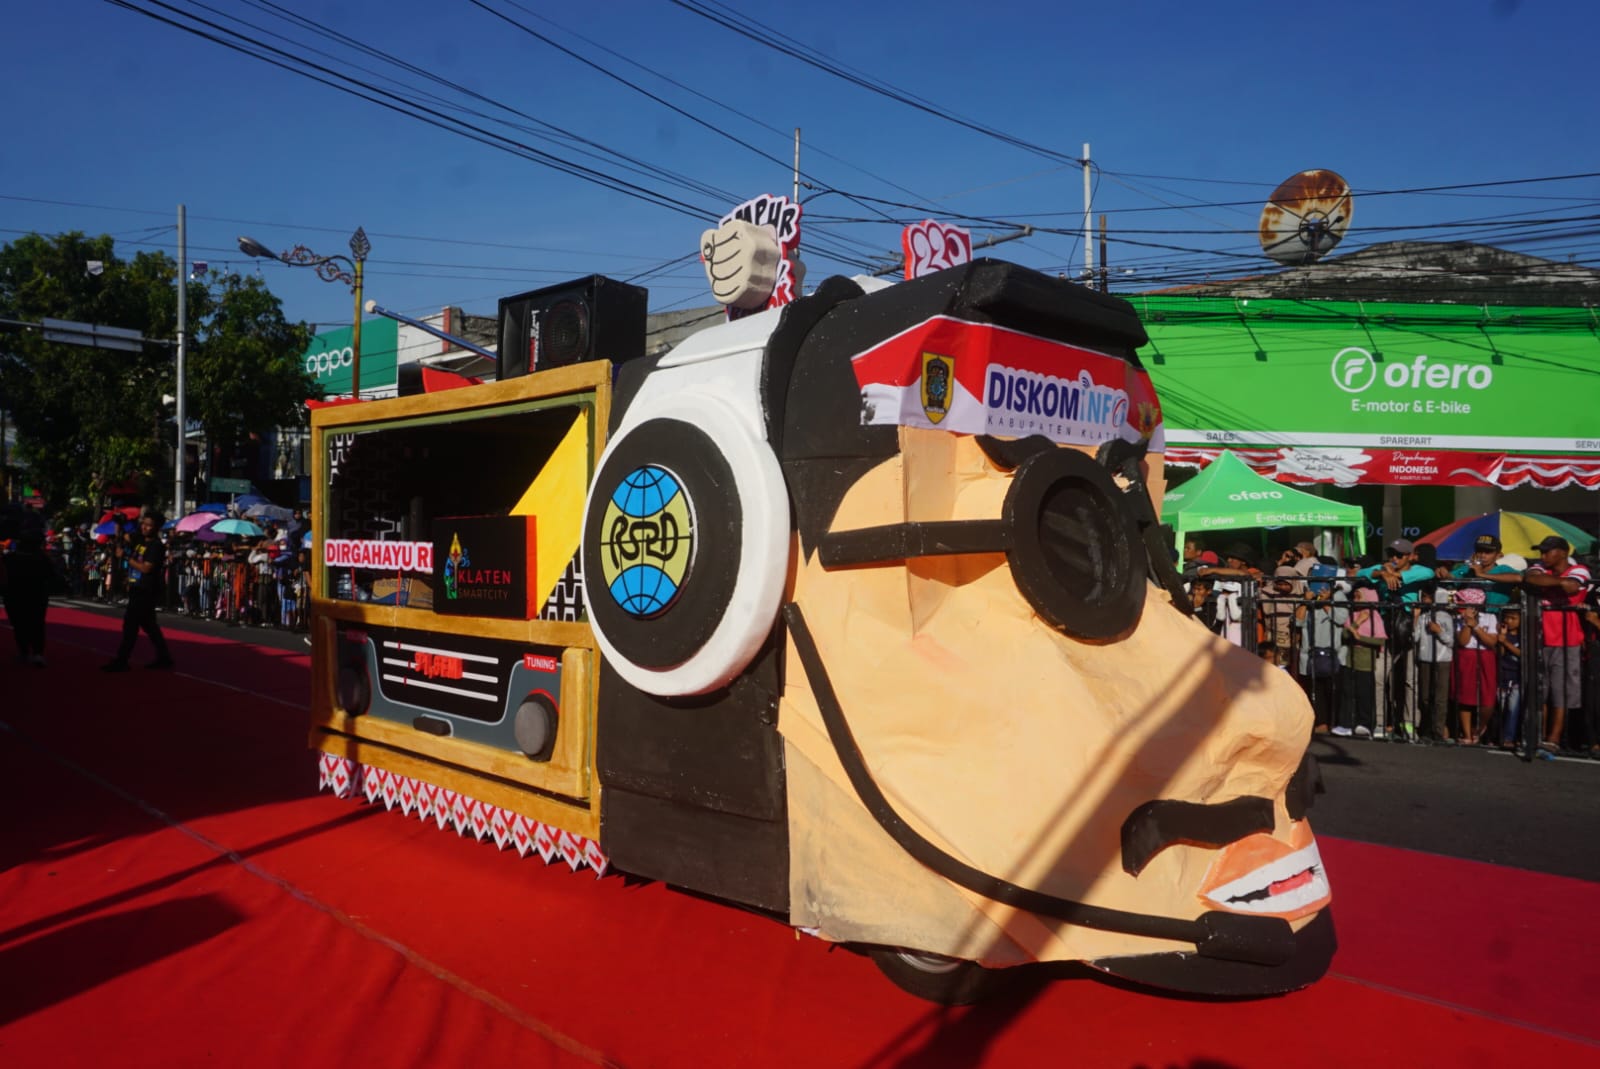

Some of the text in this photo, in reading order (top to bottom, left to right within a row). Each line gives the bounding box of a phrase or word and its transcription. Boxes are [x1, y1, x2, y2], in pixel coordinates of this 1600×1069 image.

[306, 346, 353, 378] oppo
[1384, 354, 1493, 390] ofero
[1351, 399, 1471, 414] E-motor & E-bike
[1206, 432, 1235, 441] SALES
[1380, 436, 1432, 445] SPAREPART
[1389, 465, 1439, 474] INDONESIA
[1228, 490, 1284, 501] ofero
[326, 542, 412, 568] DIRGAHAYU
[458, 570, 511, 585] KLATEN
[459, 588, 508, 600] SMARTCITY
[526, 655, 555, 669] TUNING
